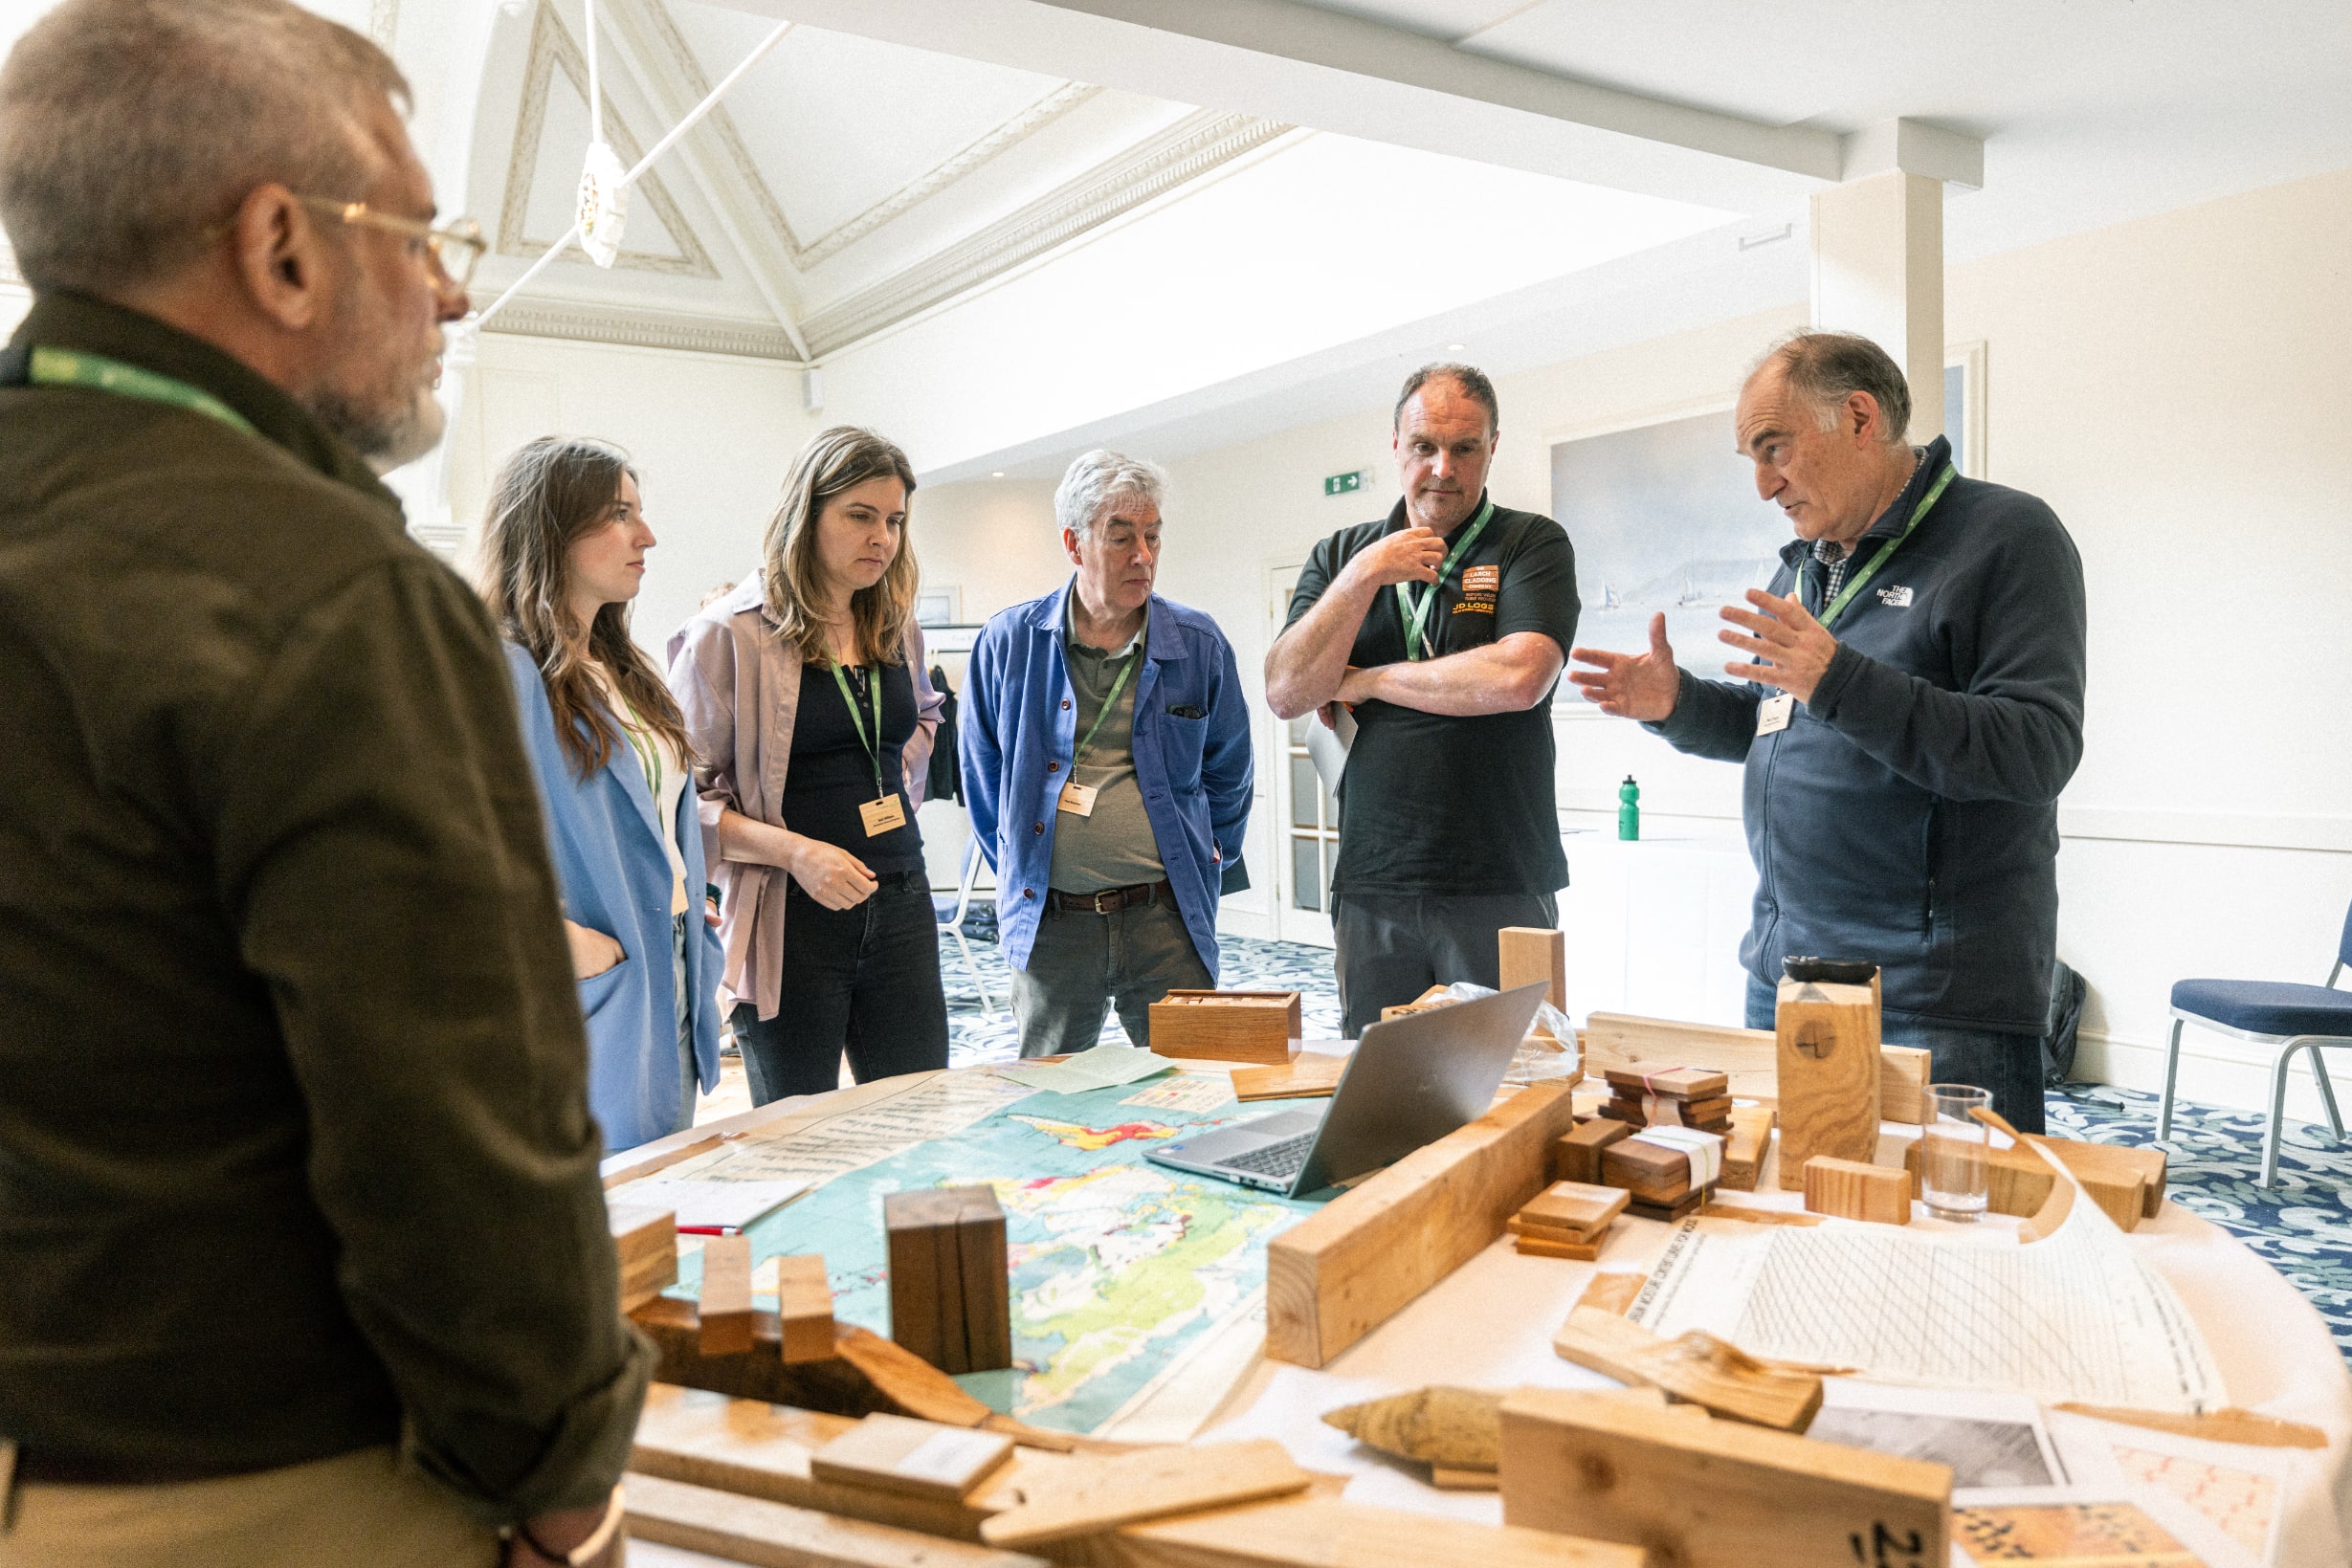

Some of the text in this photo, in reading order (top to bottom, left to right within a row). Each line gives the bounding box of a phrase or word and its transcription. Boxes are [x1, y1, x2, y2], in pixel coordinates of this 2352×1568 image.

[1892, 585, 1906, 593] THE
[1876, 588, 1902, 600] NORTH
[1467, 602, 1494, 610] LOGS
